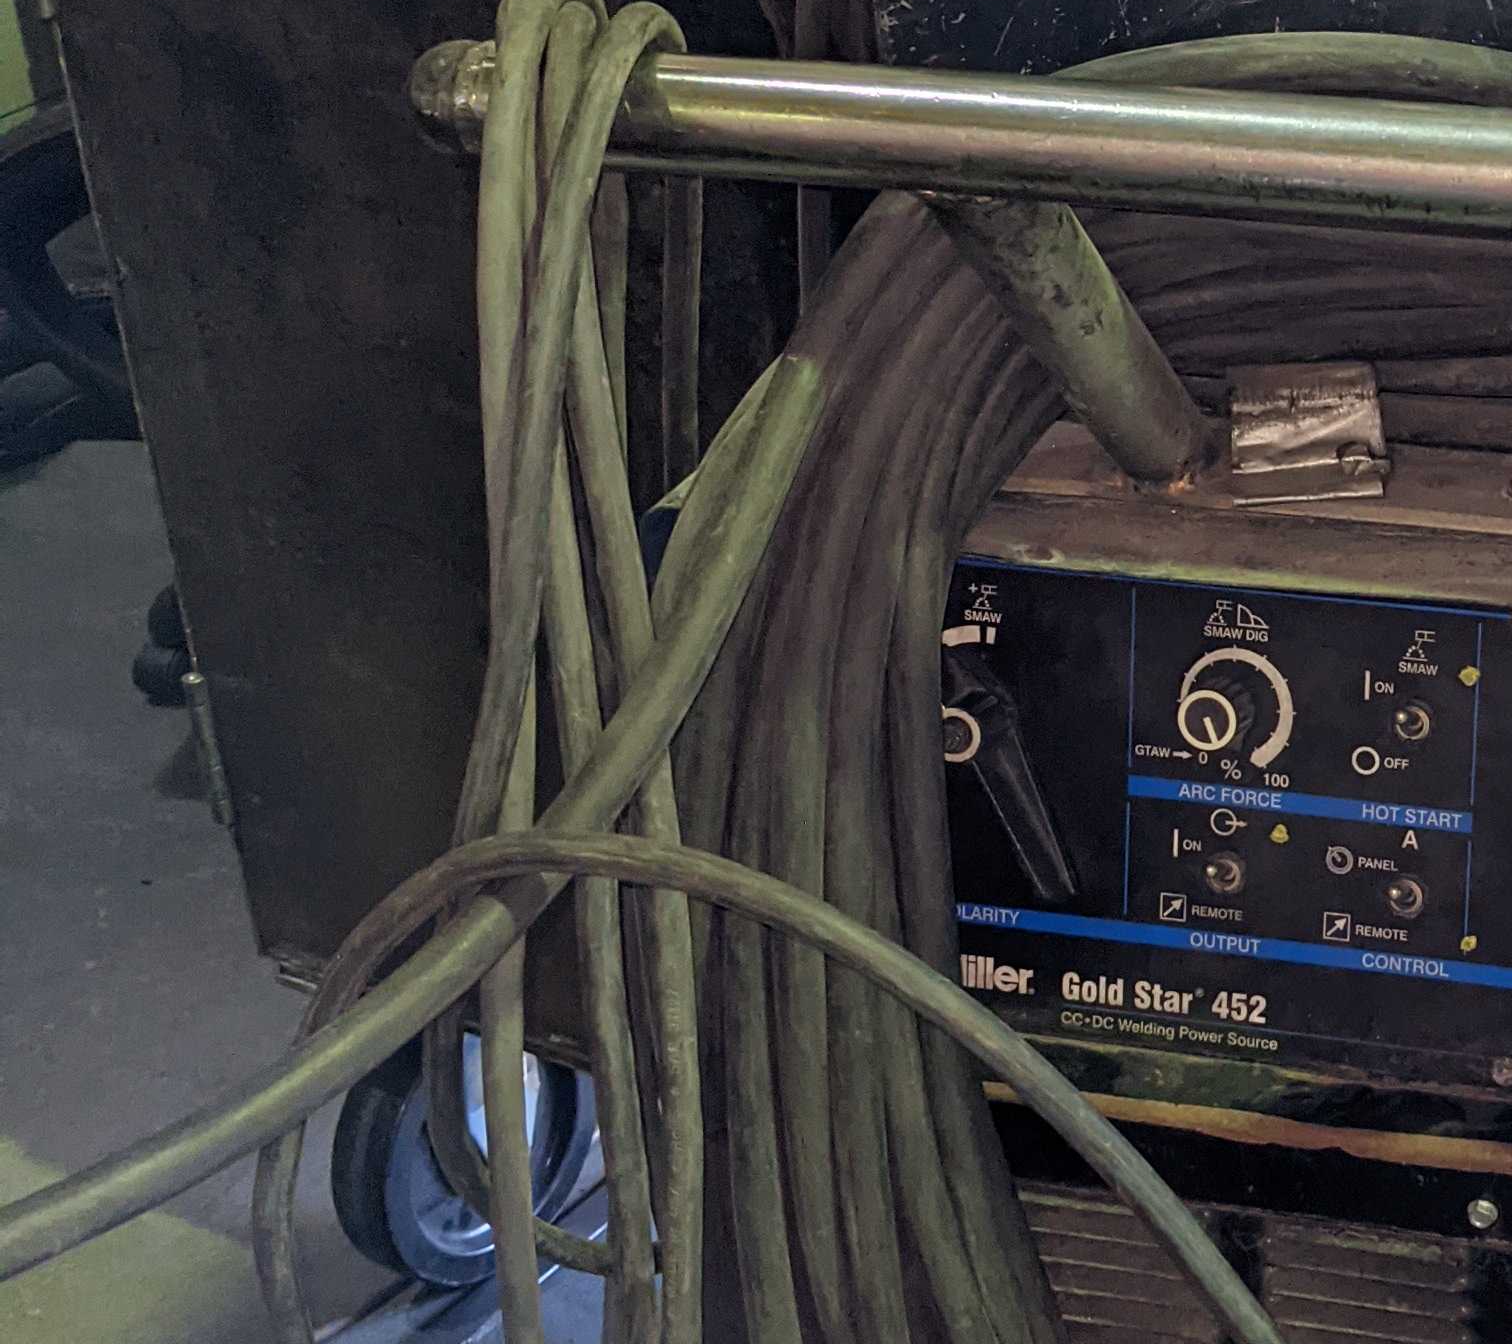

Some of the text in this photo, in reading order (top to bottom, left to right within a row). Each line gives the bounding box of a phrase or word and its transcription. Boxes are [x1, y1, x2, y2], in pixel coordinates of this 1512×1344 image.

[964, 609, 1002, 623] SMAW
[1204, 625, 1268, 643] SMAW DIG
[1399, 661, 1438, 676] SMAW
[1375, 682, 1394, 694] ON
[1135, 745, 1170, 758] GTAW
[1221, 759, 1242, 780] %
[1384, 758, 1409, 770] OFF
[1263, 773, 1289, 788] 100
[1179, 783, 1282, 808] ARC FORCE
[1362, 804, 1462, 829] HOT START
[1183, 839, 1201, 851] ON
[1401, 830, 1419, 850] A
[1358, 857, 1398, 871] PANEL
[957, 905, 1020, 924] LARITY
[1192, 905, 1243, 921] REMOTE
[1355, 924, 1408, 941] REMOTE
[1190, 932, 1260, 954] OUTPUT
[1362, 953, 1449, 977] CONTROL
[1062, 971, 1267, 1024] Gold Star 452
[1118, 1017, 1174, 1040] Welding
[1179, 1026, 1223, 1044] Power
[1227, 1032, 1278, 1050] Source
